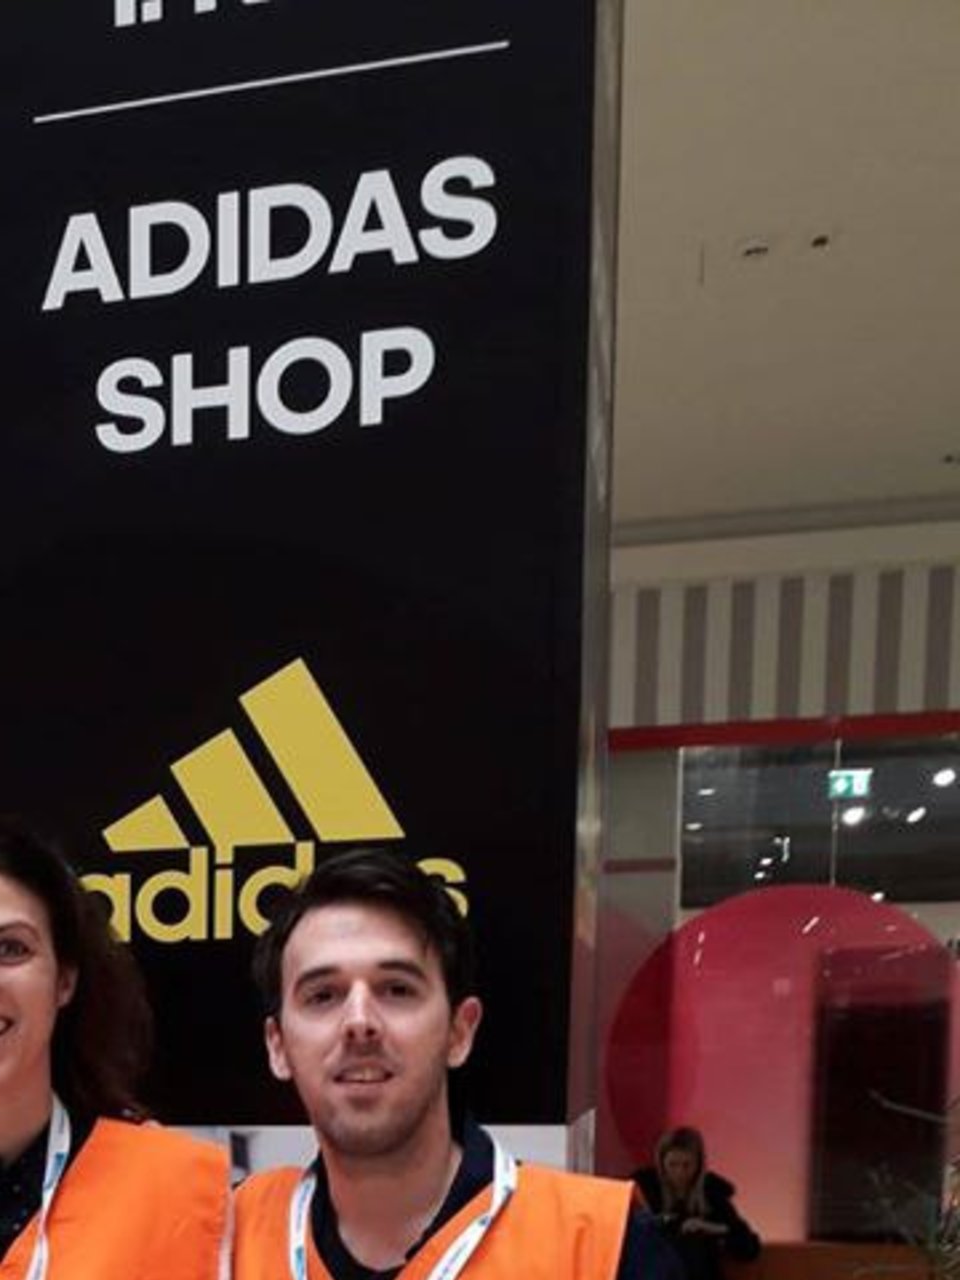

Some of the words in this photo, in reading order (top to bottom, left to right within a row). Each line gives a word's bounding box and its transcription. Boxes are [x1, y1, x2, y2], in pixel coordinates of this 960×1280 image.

[41, 155, 499, 311] ADIDAS
[95, 326, 437, 455] SHOP
[77, 842, 469, 943] adids
